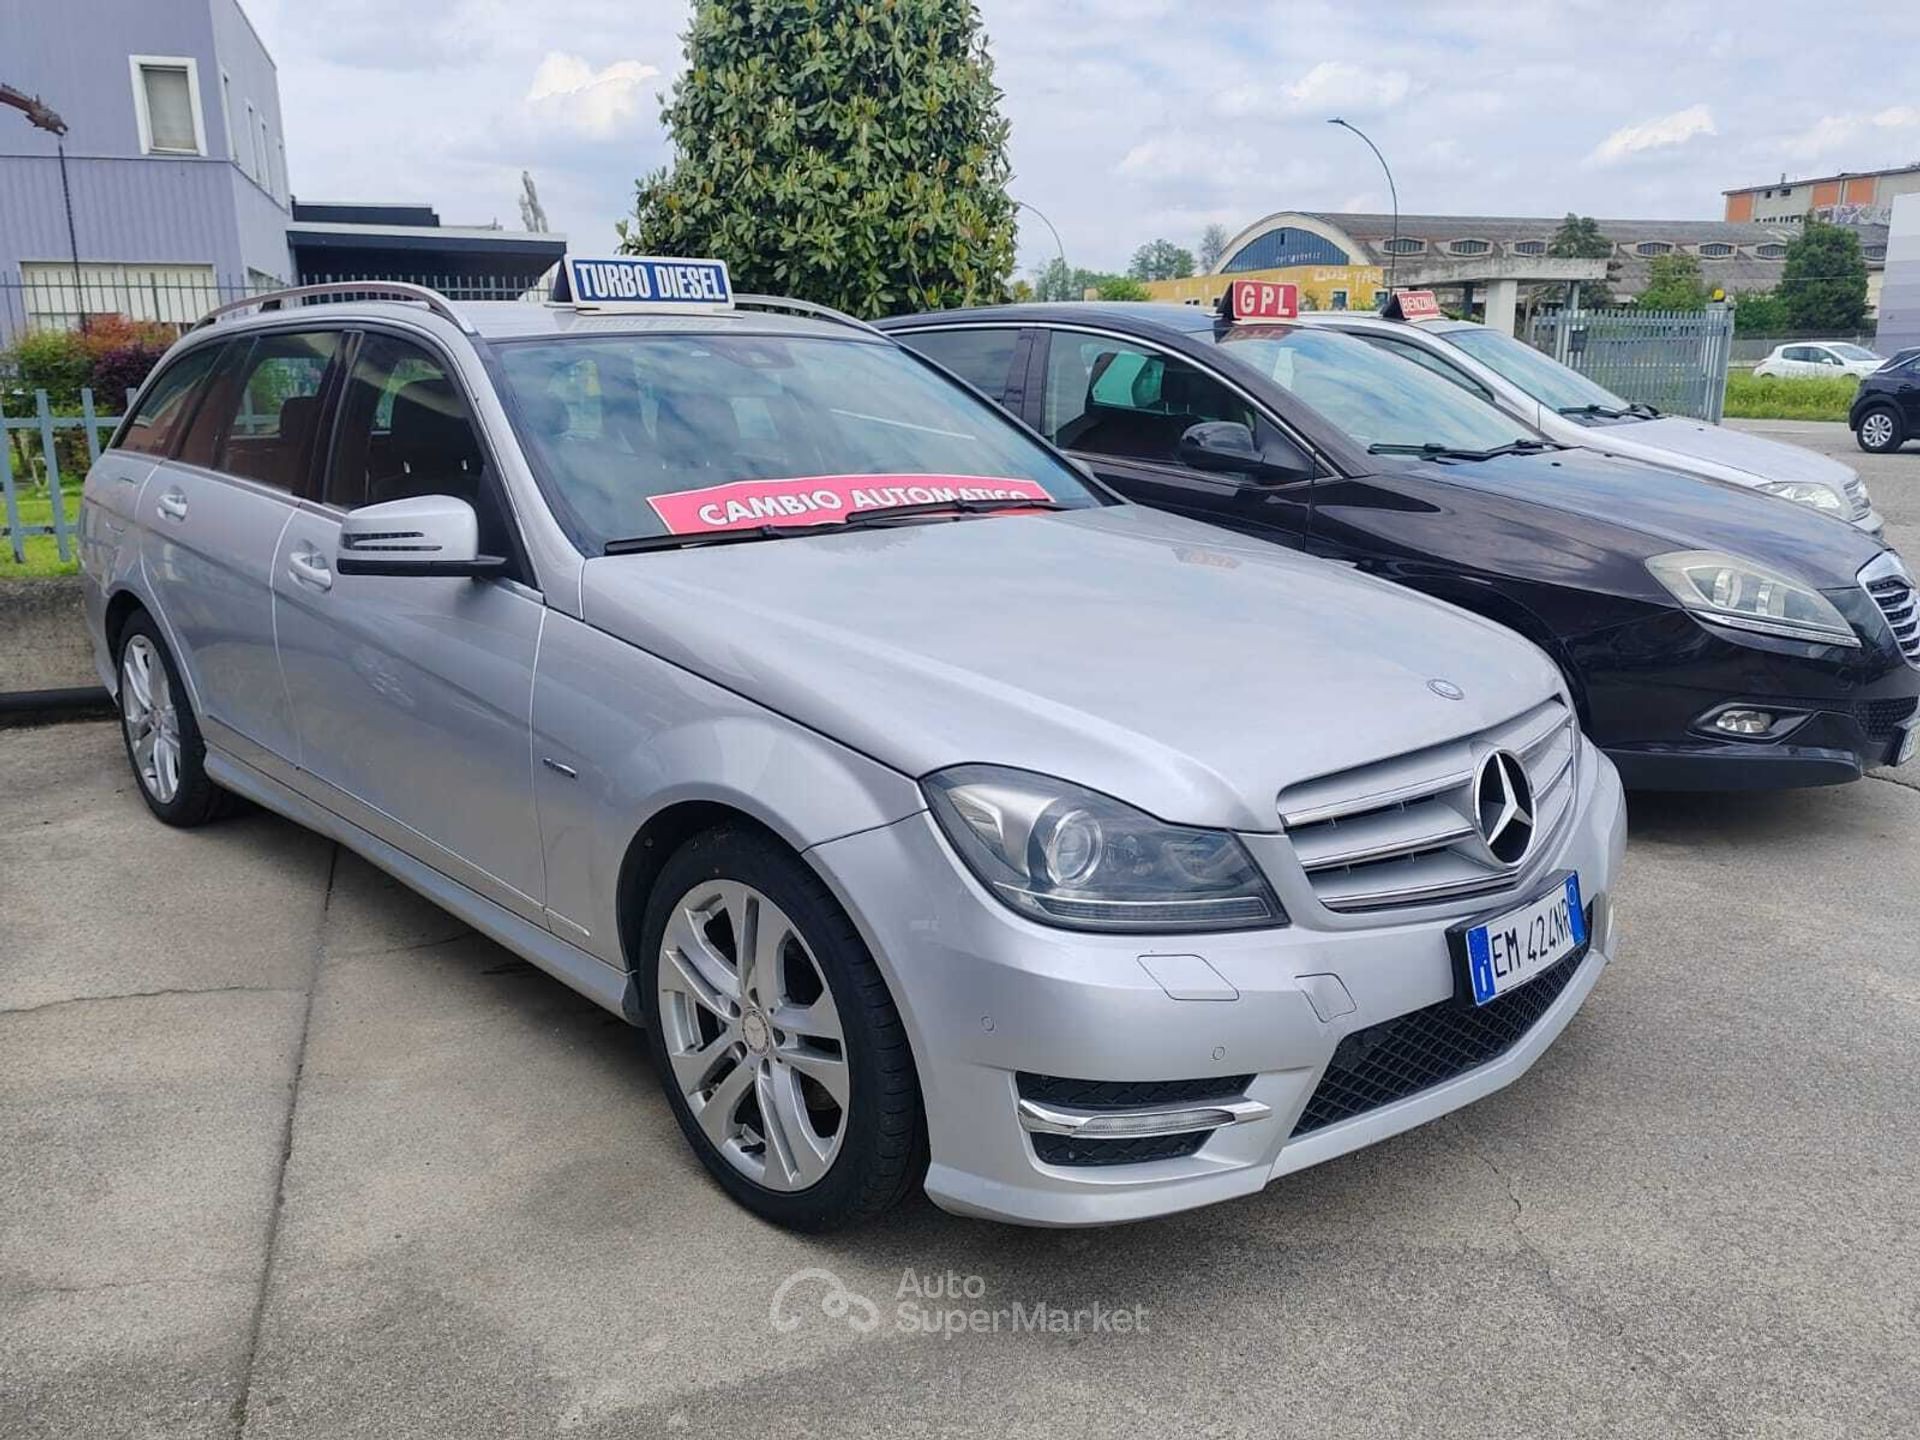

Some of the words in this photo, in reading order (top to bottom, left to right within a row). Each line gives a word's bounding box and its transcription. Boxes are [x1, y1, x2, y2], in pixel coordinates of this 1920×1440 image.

[575, 262, 652, 299] TURBO
[653, 264, 726, 300] DIESEL
[1240, 284, 1290, 315] GPL
[699, 490, 842, 525] CAMBIO
